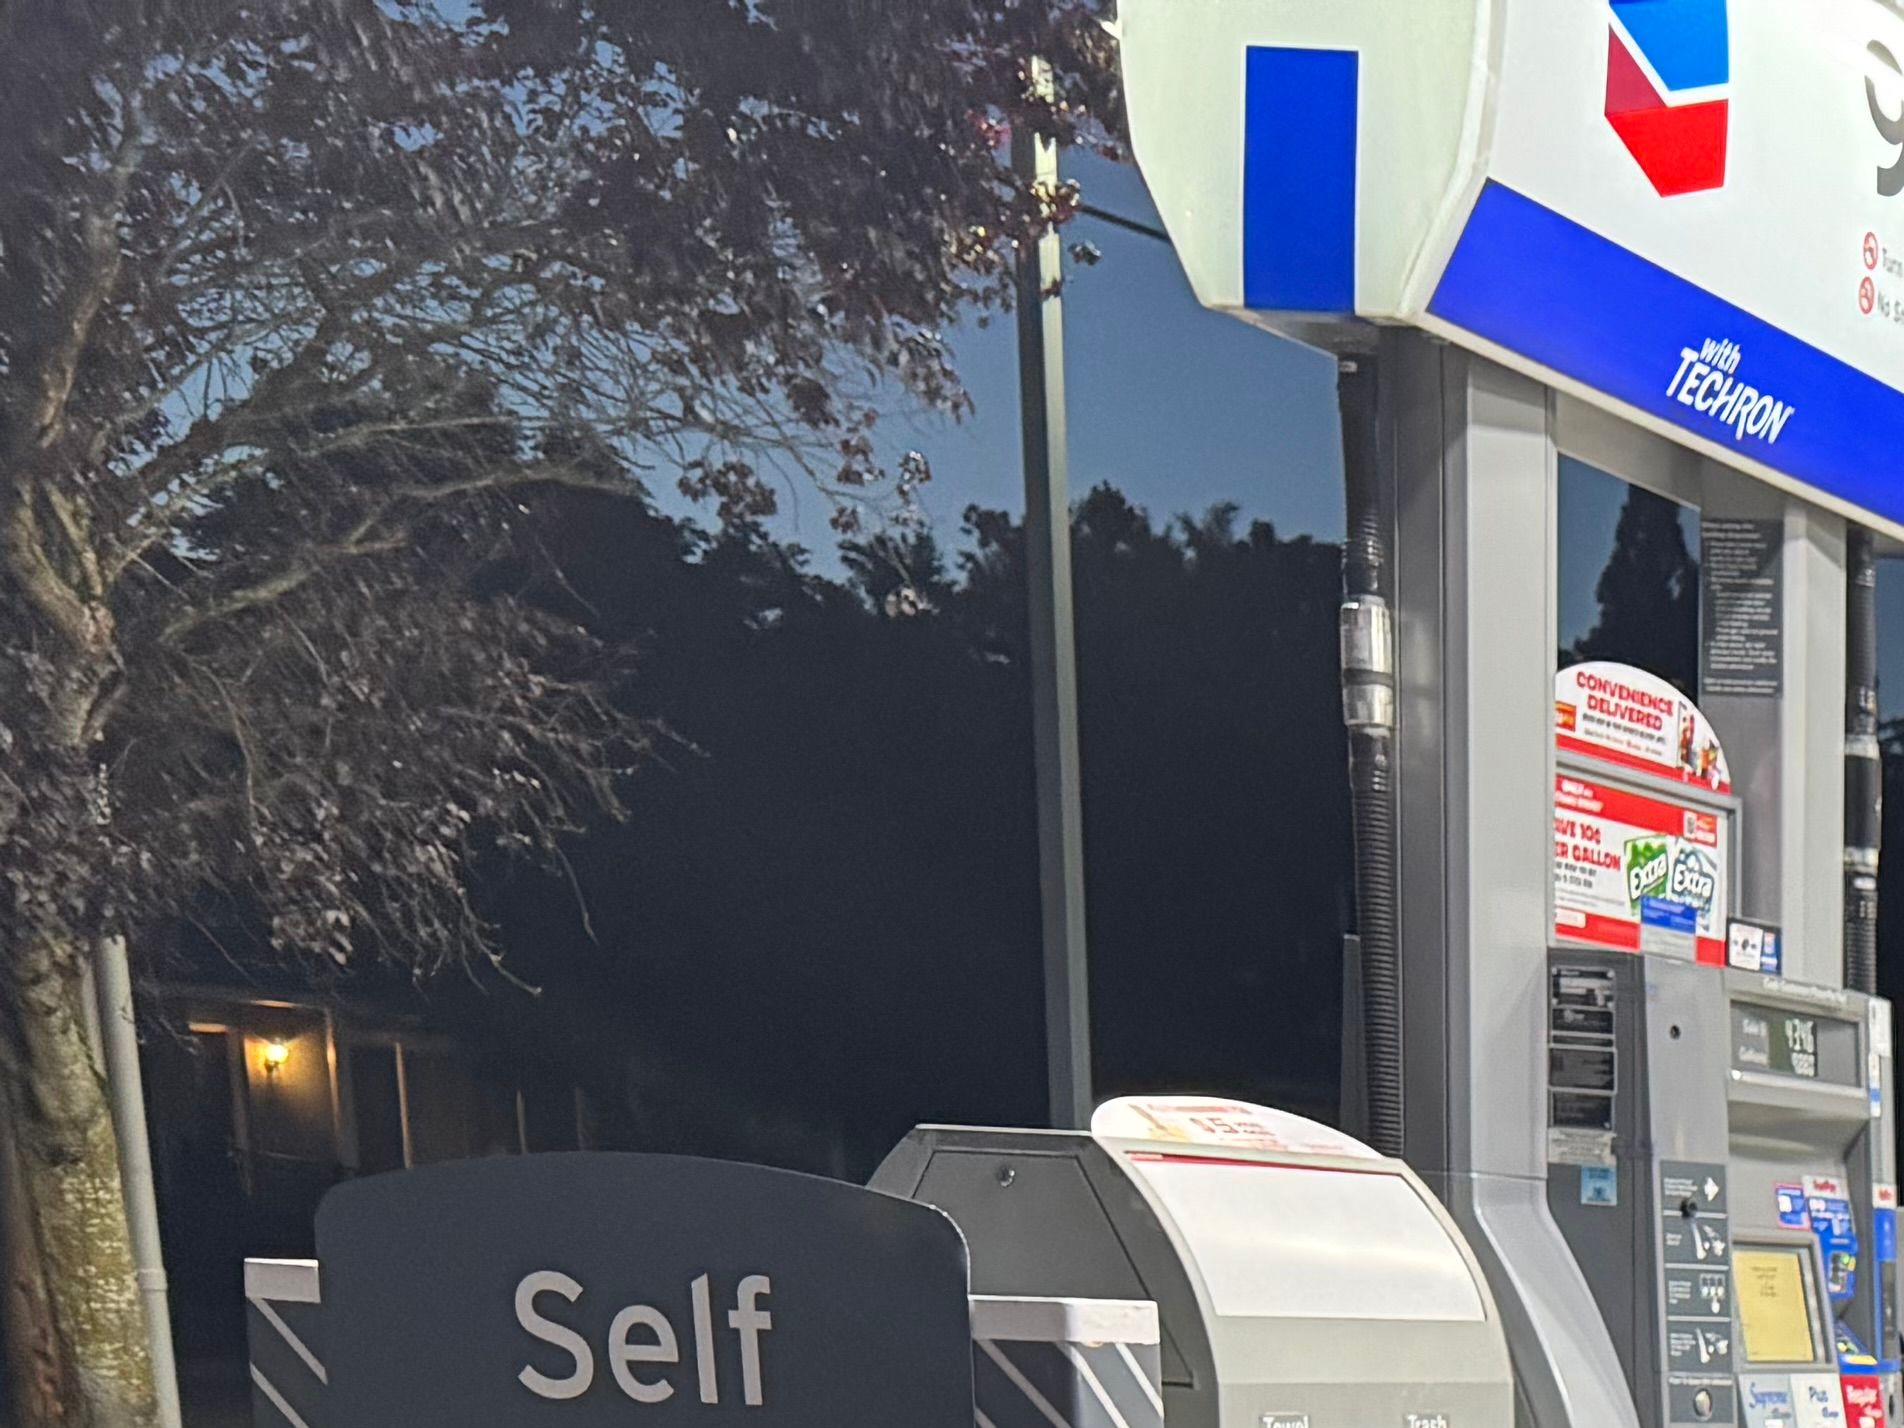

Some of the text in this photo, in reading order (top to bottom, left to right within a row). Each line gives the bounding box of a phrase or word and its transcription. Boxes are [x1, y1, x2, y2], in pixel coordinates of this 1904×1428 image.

[1881, 246, 1903, 278] Turn
[1877, 290, 1890, 317] No
[1699, 337, 1742, 374] with
[1665, 346, 1793, 445] TECHRON
[1575, 671, 1674, 716] CONVENIENCE
[1586, 694, 1663, 731] DELIVERED
[1572, 844, 1622, 871] GALLON
[515, 1270, 772, 1405] Self
